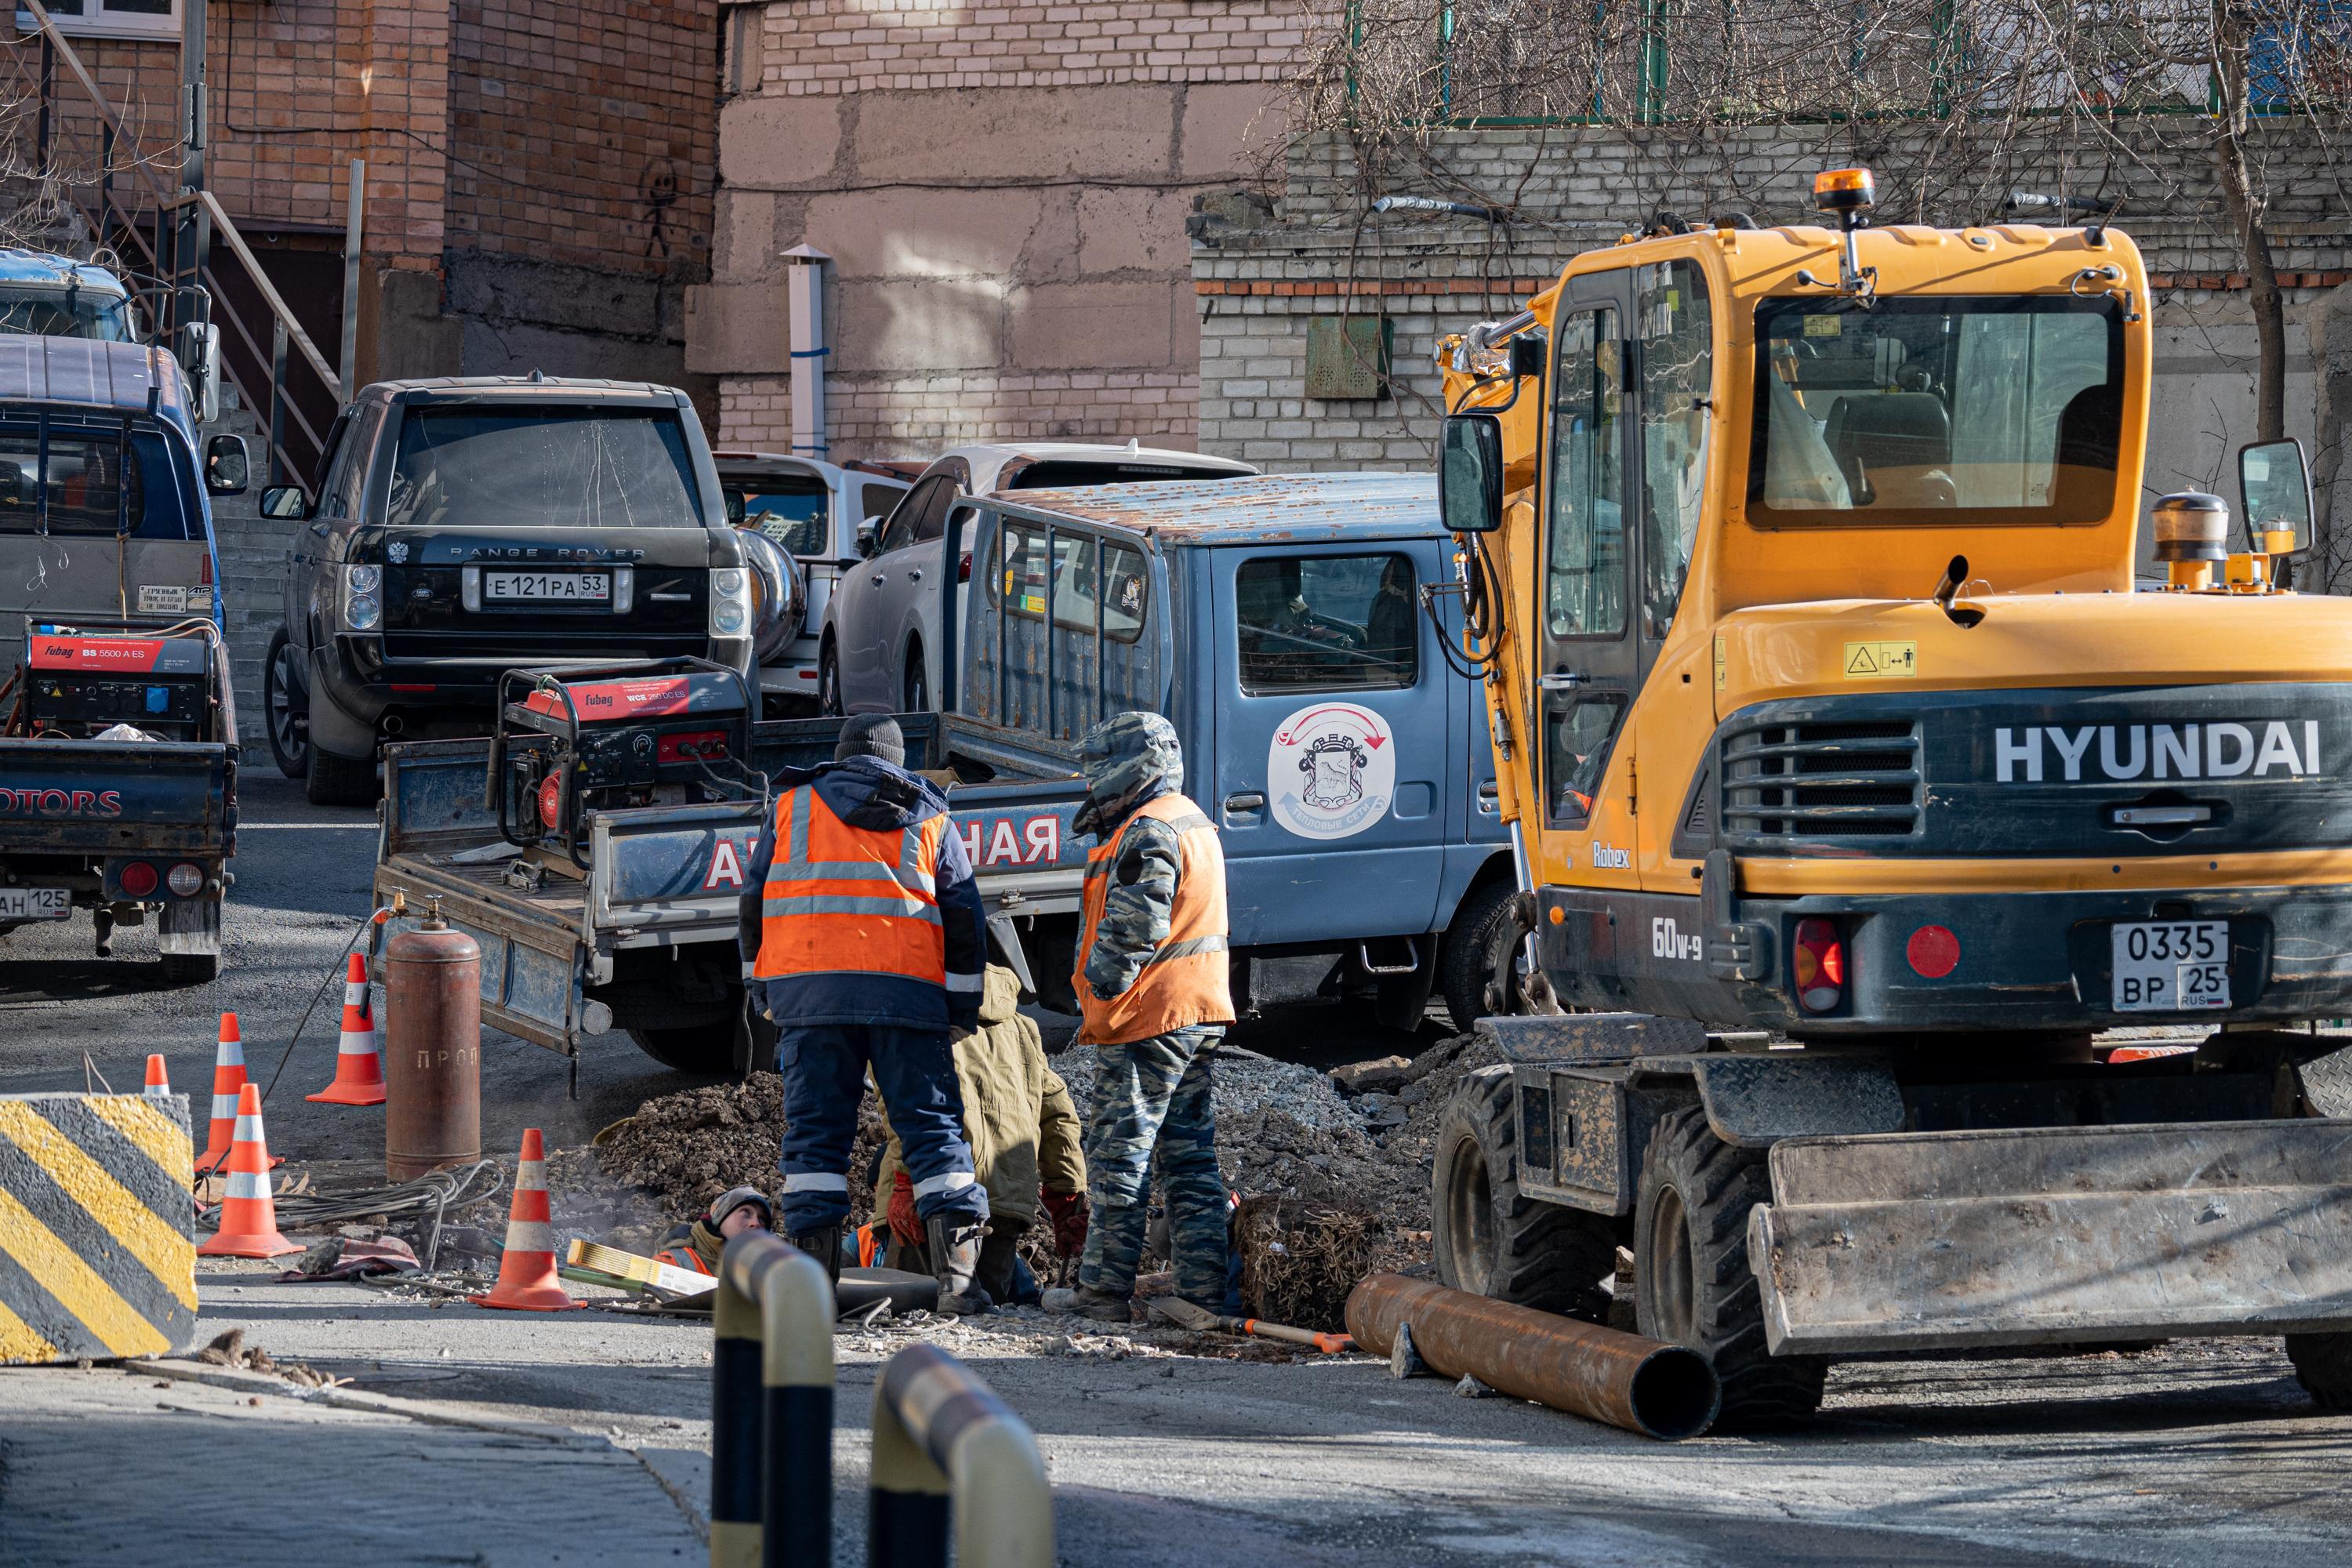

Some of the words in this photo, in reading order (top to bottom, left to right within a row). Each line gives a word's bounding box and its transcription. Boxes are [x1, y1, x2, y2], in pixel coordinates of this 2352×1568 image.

[450, 547, 539, 557] RANGE
[557, 548, 645, 557] ROVER
[582, 576, 601, 590] 53
[1995, 720, 2321, 782] HYUNDAI
[1293, 808, 1342, 829] ТЕПЛОВЫЕ
[1347, 802, 1371, 823] СЕТИ
[1593, 840, 1631, 869] Robex
[31, 891, 66, 907] 125
[2128, 925, 2215, 961] 0335
[2188, 967, 2220, 993] 25
[2181, 996, 2206, 1005] RUS
